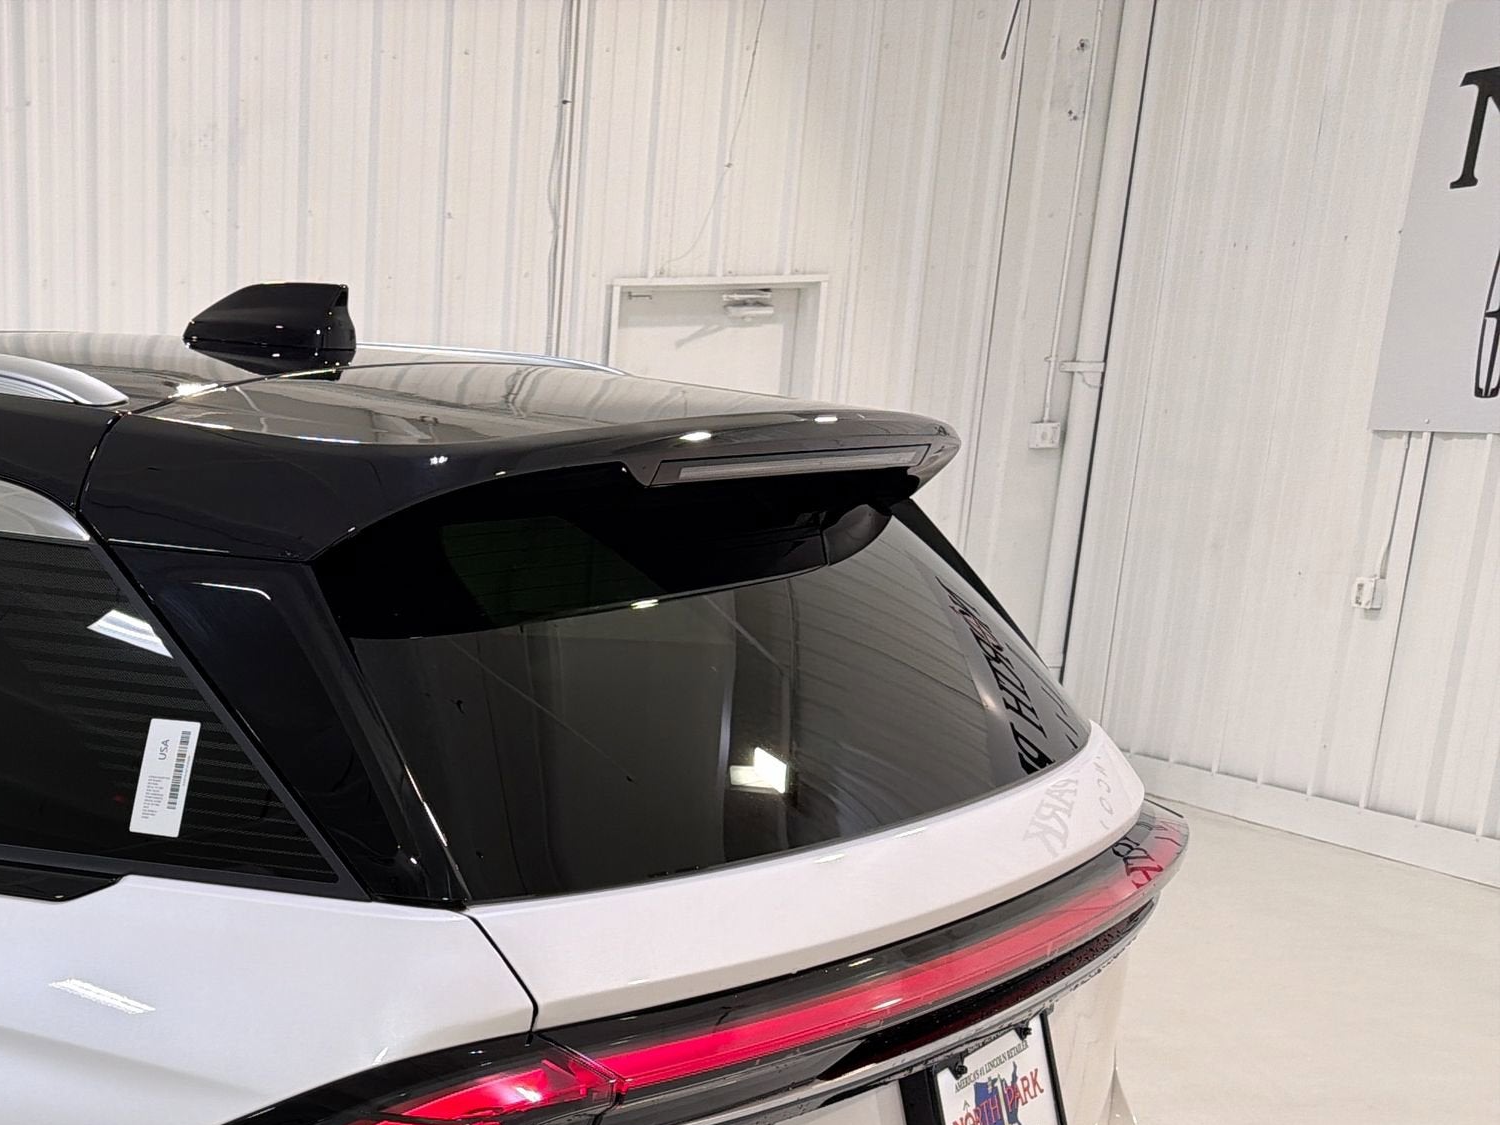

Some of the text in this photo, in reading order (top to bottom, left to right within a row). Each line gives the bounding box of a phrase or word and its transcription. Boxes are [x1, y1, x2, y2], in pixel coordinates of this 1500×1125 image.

[158, 739, 170, 760] USA
[954, 1069, 980, 1094] AMERICA'S
[985, 1052, 1007, 1073] LINCOLN
[1006, 1040, 1029, 1060] RETAILER
[1004, 1068, 1044, 1111] PARK
